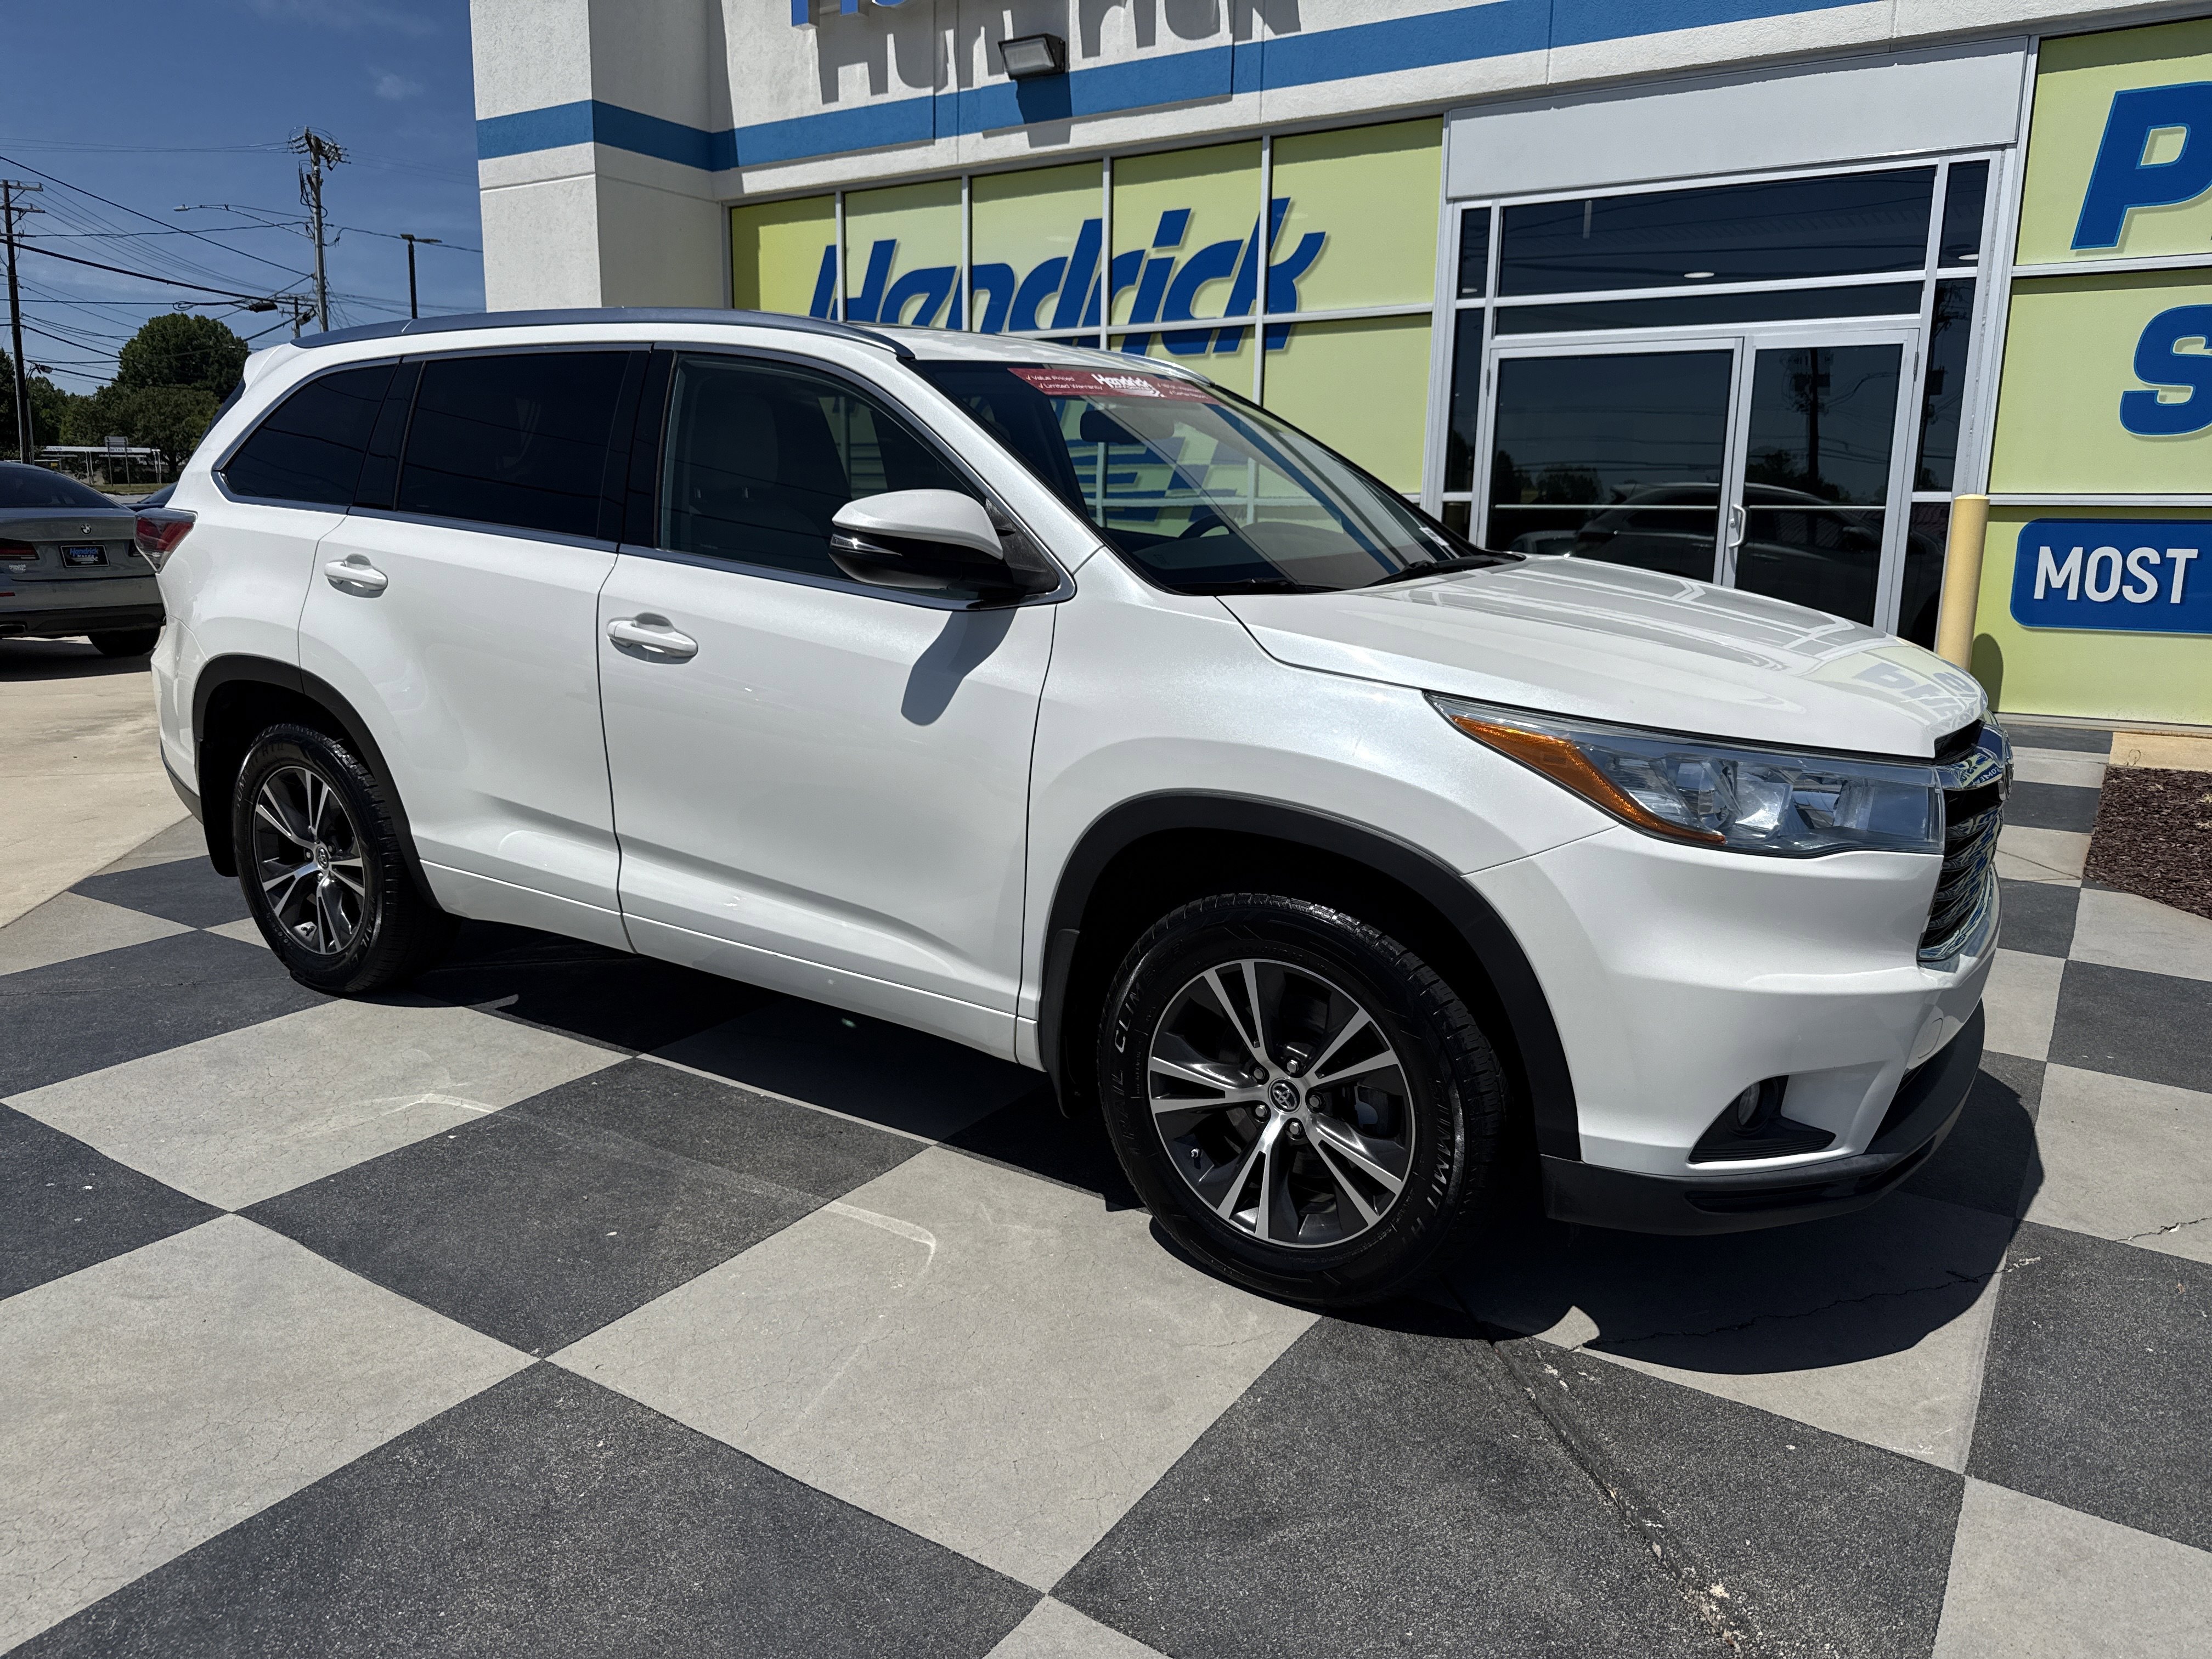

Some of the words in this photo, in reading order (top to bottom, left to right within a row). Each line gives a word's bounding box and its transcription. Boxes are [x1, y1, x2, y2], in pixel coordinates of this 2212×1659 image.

[2070, 81, 2212, 250] P
[810, 198, 1325, 357] Hendrick
[2034, 546, 2198, 603] MOST
